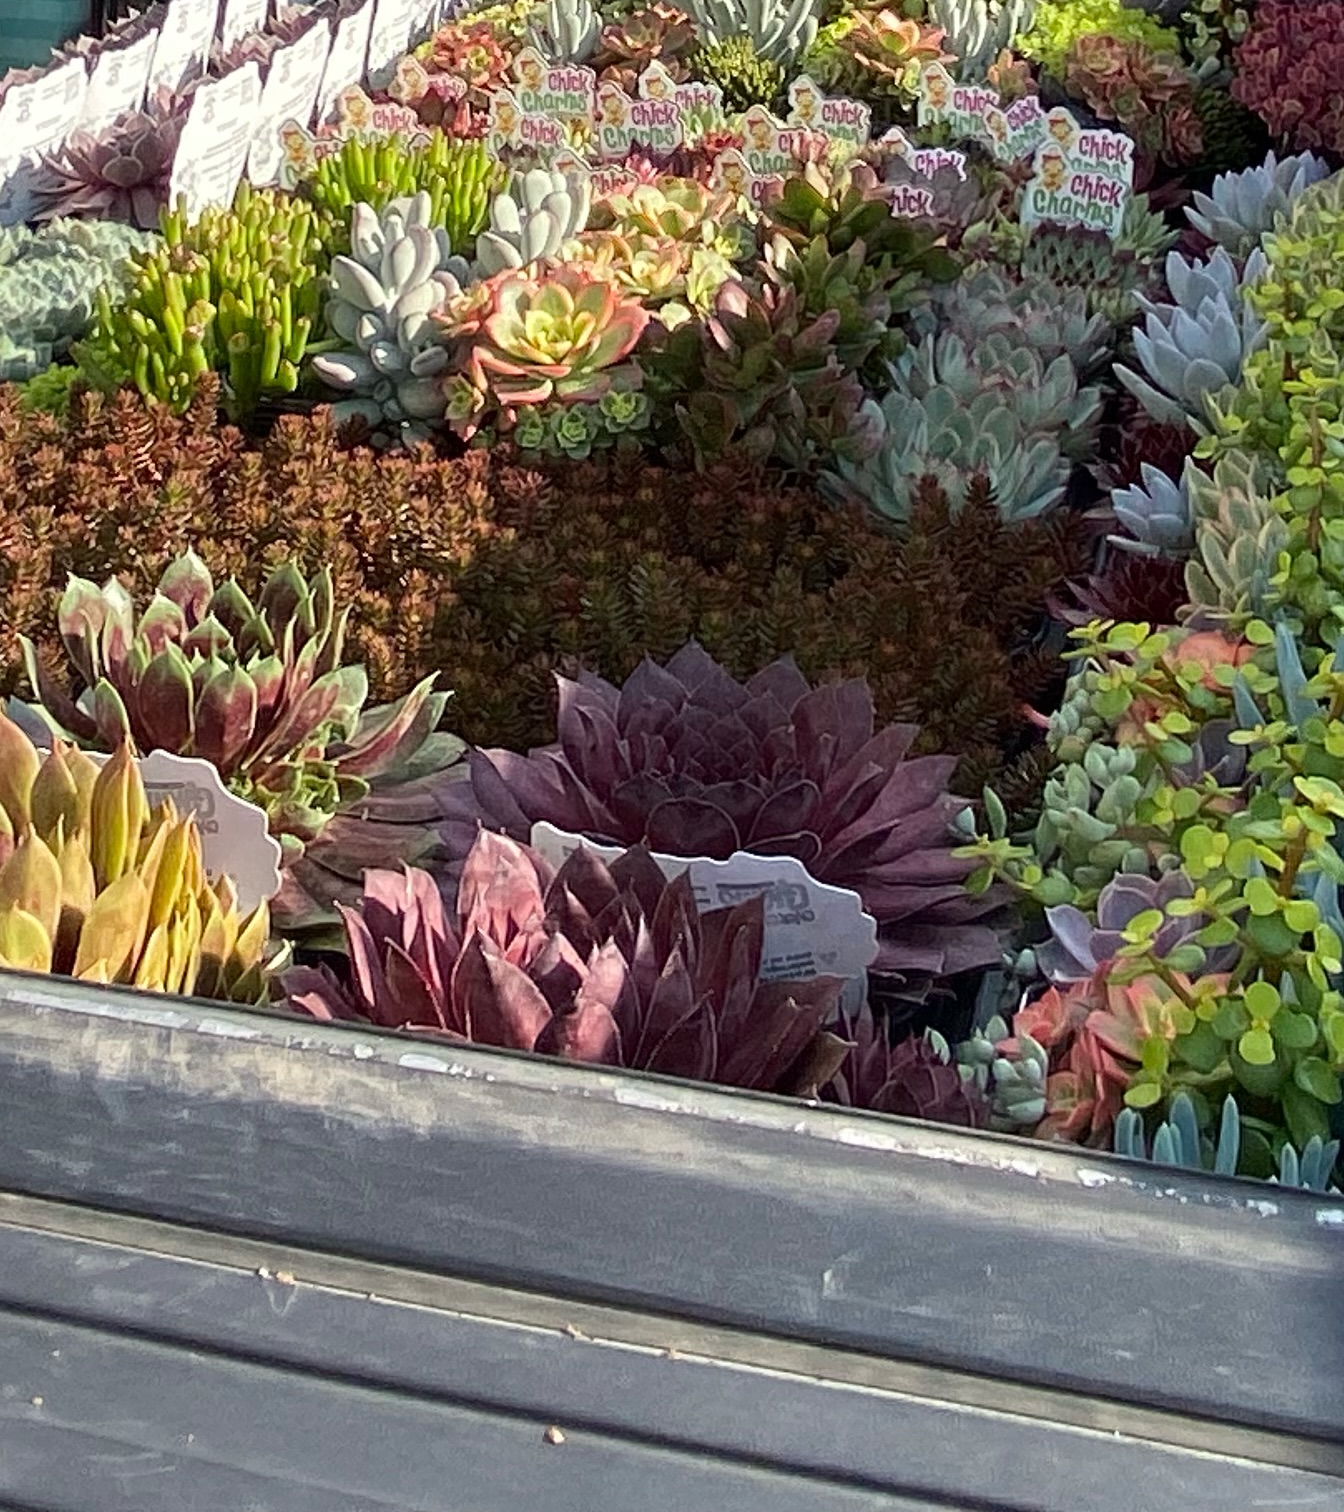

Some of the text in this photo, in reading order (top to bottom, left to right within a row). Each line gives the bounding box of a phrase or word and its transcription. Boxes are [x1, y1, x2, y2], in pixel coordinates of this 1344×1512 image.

[549, 70, 589, 94] Chick
[521, 91, 587, 112] Charms
[631, 102, 676, 129] Chick
[822, 102, 864, 129] Chick
[520, 118, 561, 148] Chick
[1079, 134, 1127, 165] Chick
[891, 187, 930, 215] hick
[1070, 174, 1123, 208] Chick
[1032, 189, 1114, 227] Charms
